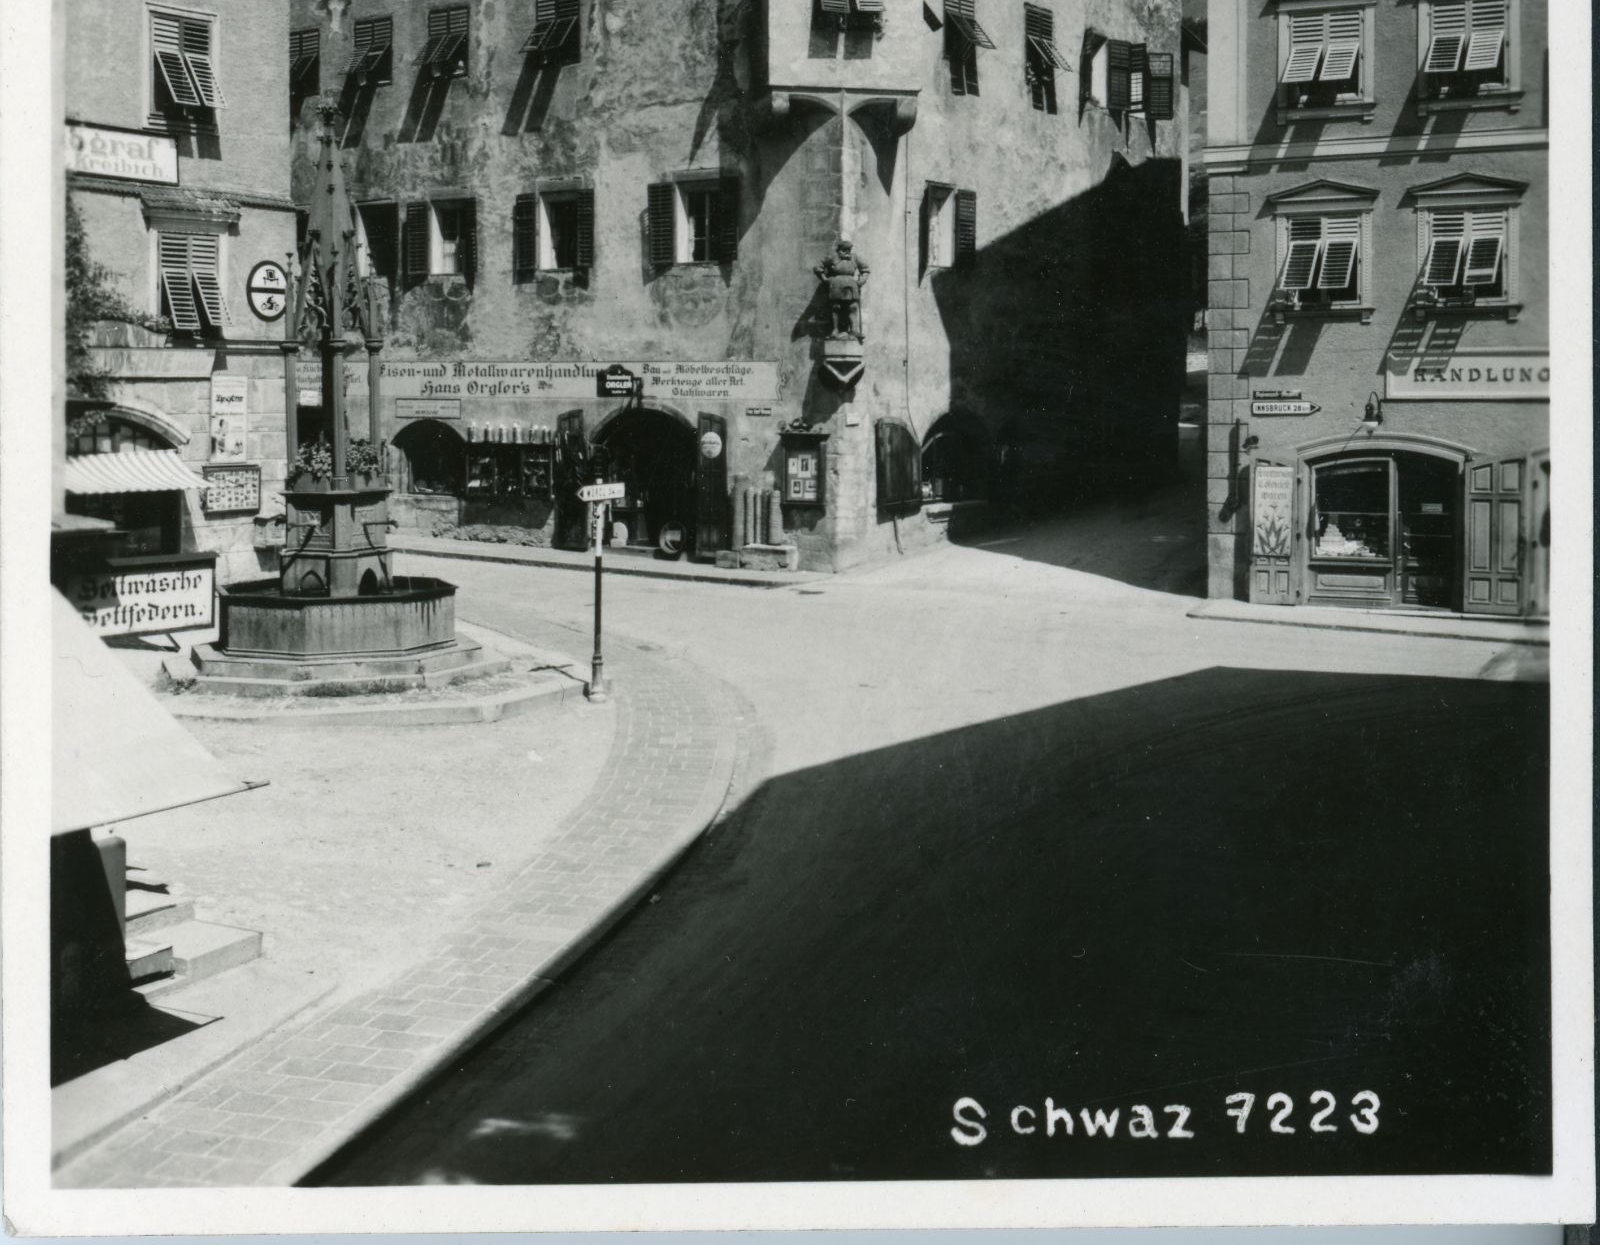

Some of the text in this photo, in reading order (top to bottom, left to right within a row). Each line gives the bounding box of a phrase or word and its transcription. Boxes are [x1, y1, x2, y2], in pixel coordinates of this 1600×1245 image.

[421, 380, 461, 395] Hans
[605, 381, 633, 389] ORGLER
[1255, 404, 1291, 412] INNSBRUCK
